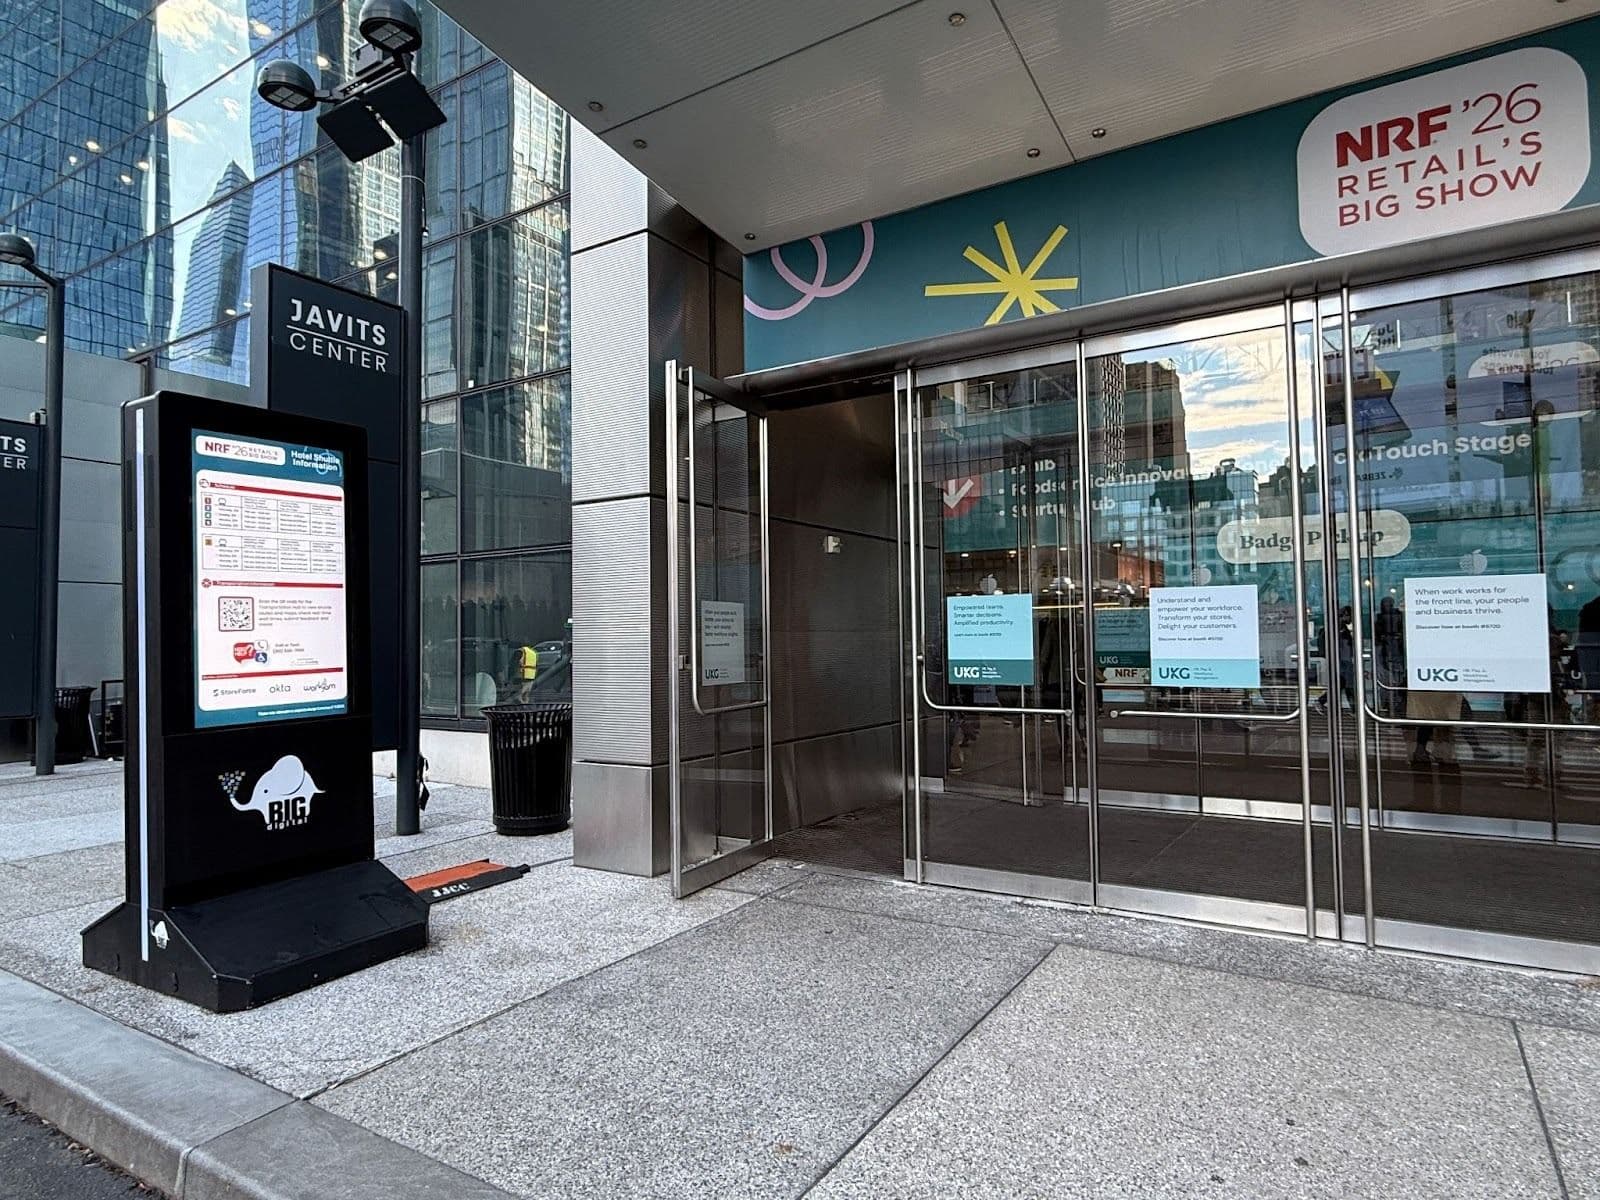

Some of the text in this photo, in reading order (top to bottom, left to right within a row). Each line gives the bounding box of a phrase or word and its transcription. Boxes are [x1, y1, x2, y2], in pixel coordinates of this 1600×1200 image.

[1336, 104, 1452, 168] NRF
[1338, 131, 1542, 199] RETAIL'S
[1339, 161, 1542, 227] BIG SHOW
[291, 298, 386, 346] JAVITS
[289, 332, 386, 373] CENTER
[205, 441, 230, 453] NRF
[1455, 433, 1532, 455] Stage
[291, 450, 340, 464] Hotel Shuttle
[292, 458, 338, 471] Information
[1474, 598, 1495, 606] your
[1497, 595, 1530, 604] people
[1158, 623, 1180, 631] Delight
[1100, 655, 1119, 664] UKG
[705, 668, 719, 679] UKG
[954, 667, 979, 678] UKG
[1115, 669, 1138, 678] NRF
[1159, 667, 1190, 679] UKG
[1417, 668, 1459, 682] UKG
[220, 688, 256, 696] StoreForce
[269, 683, 291, 694] okta
[269, 796, 307, 822] BIG
[266, 816, 308, 831] digital
